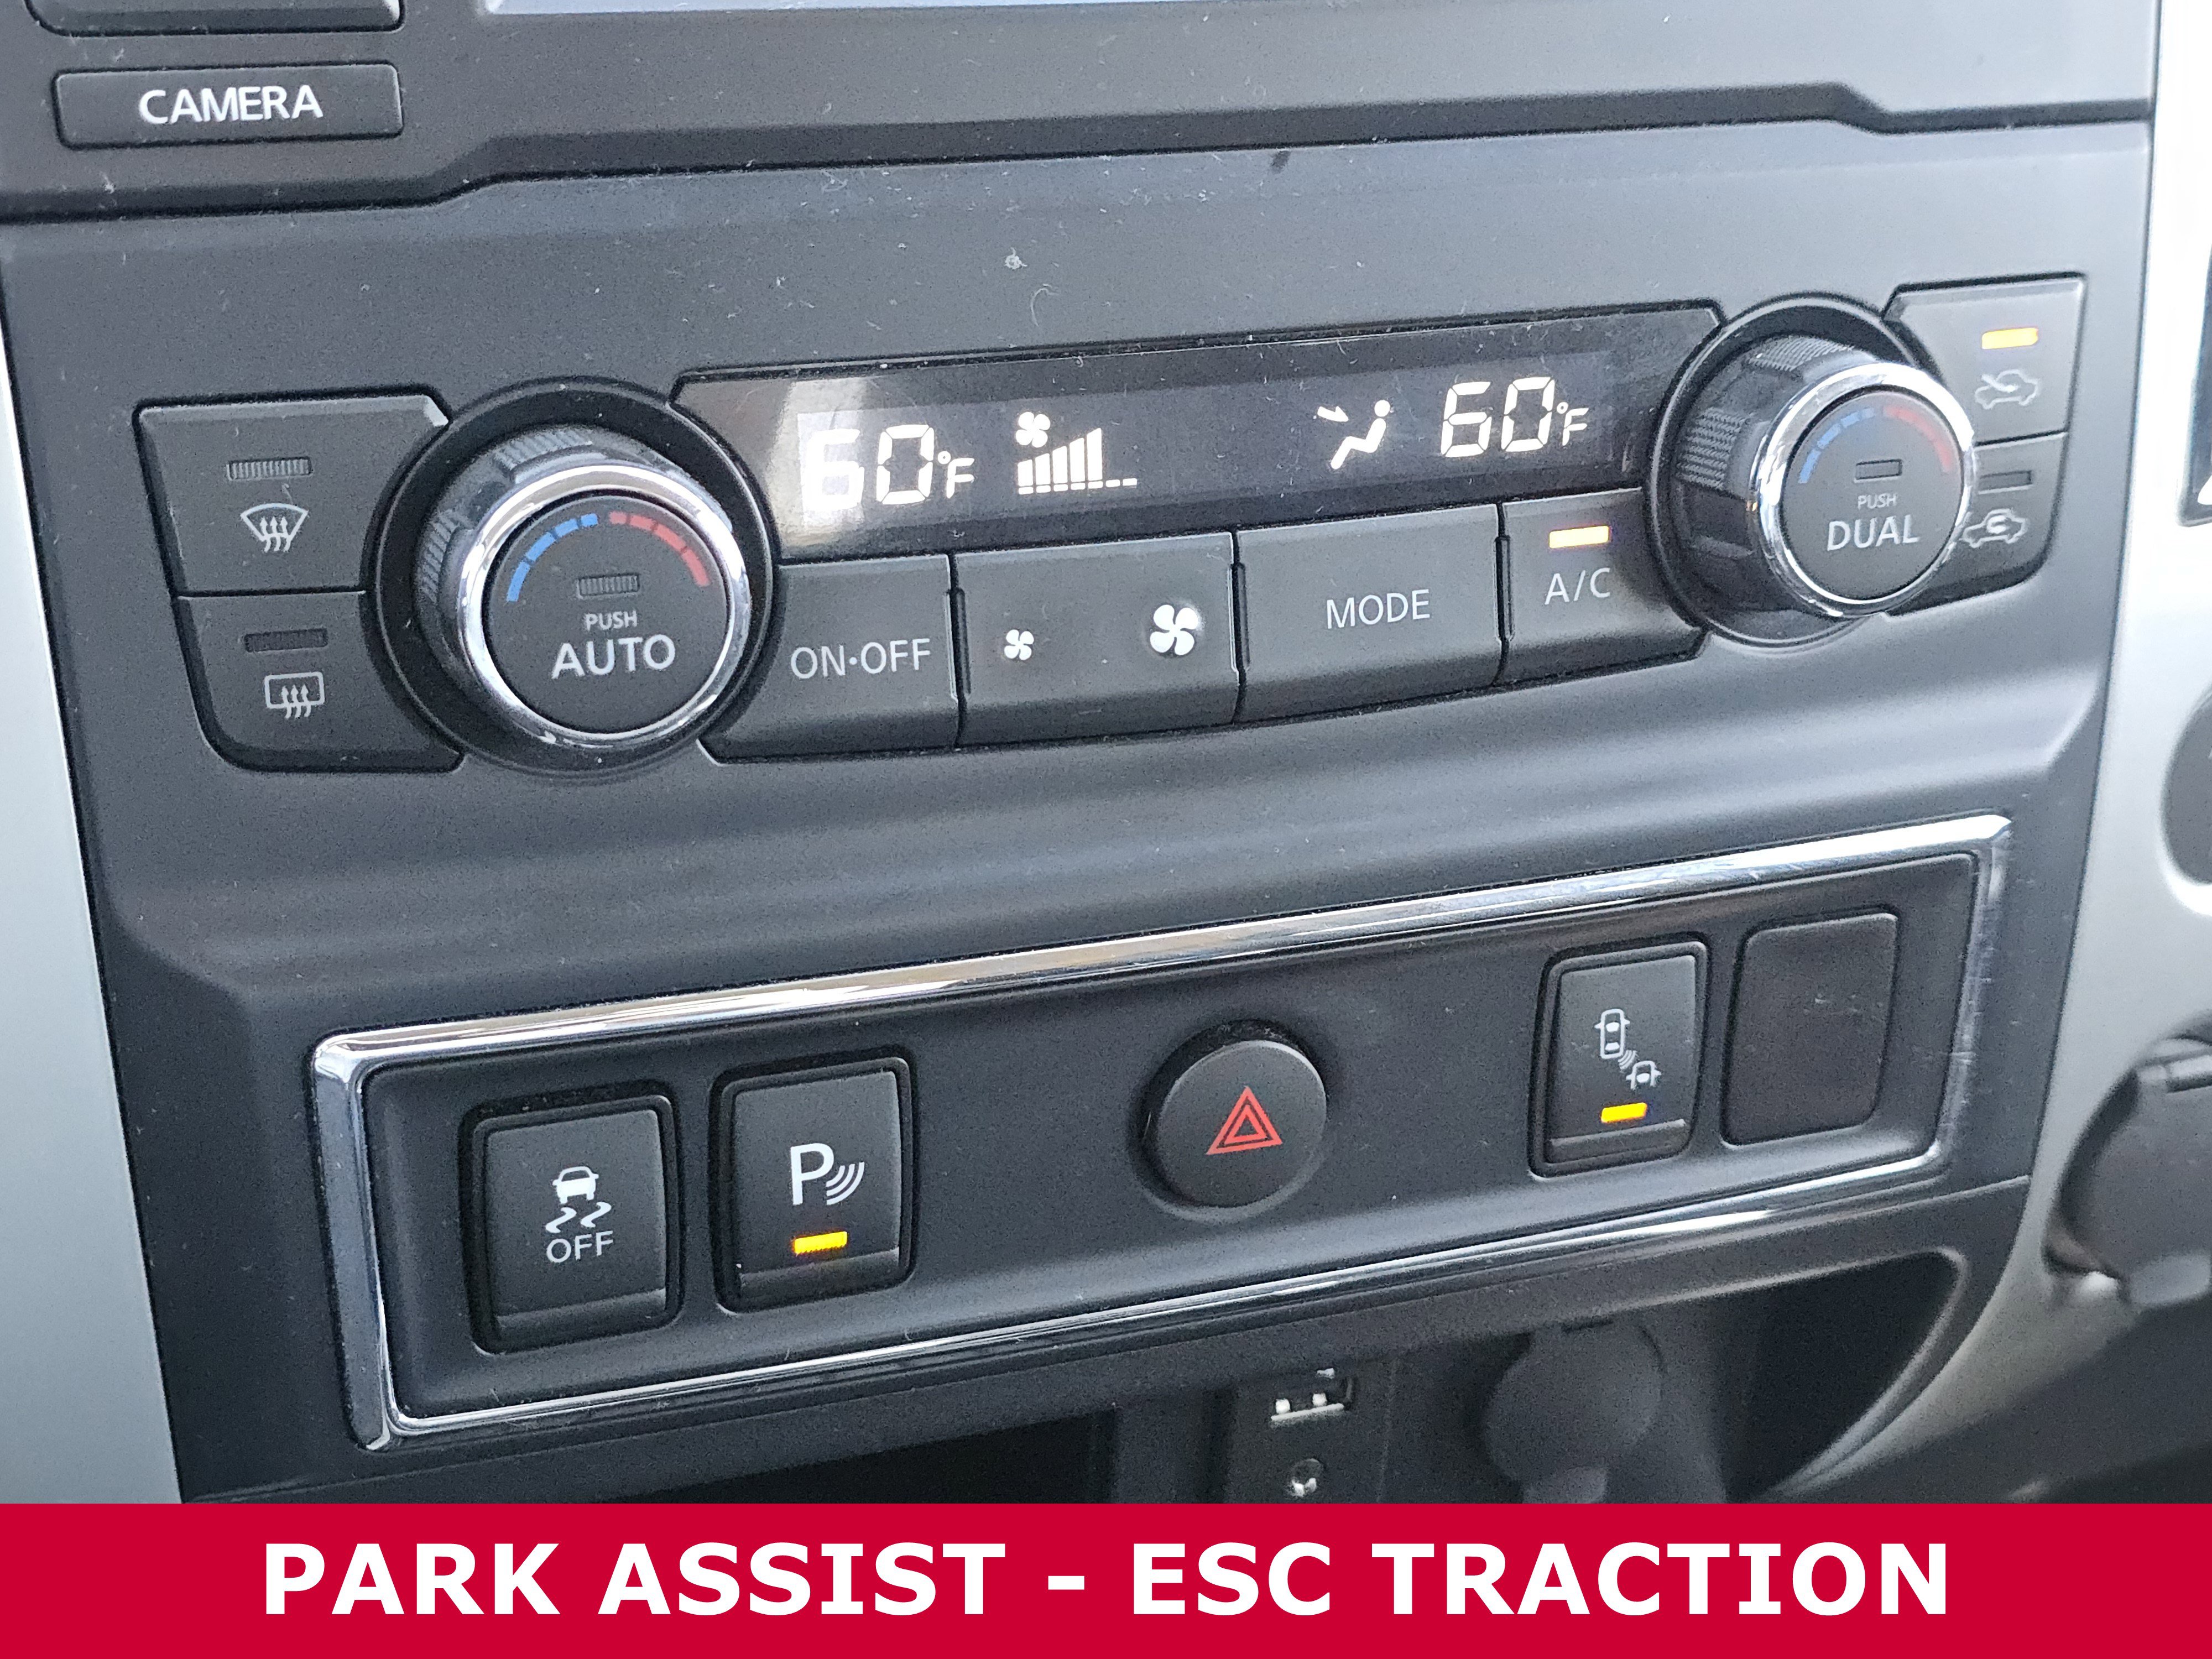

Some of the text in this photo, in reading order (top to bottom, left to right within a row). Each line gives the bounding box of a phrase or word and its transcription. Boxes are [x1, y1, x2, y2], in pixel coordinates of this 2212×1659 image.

[138, 84, 324, 125] CAMERA
[1857, 492, 1897, 510] PUSH
[1827, 514, 1921, 552] DUAL
[1545, 567, 1611, 606] A/C
[583, 610, 638, 631] PUSH
[1327, 589, 1431, 629] MODE
[551, 634, 676, 680] AUTO
[789, 1142, 834, 1206] P
[545, 1230, 614, 1264] OFF
